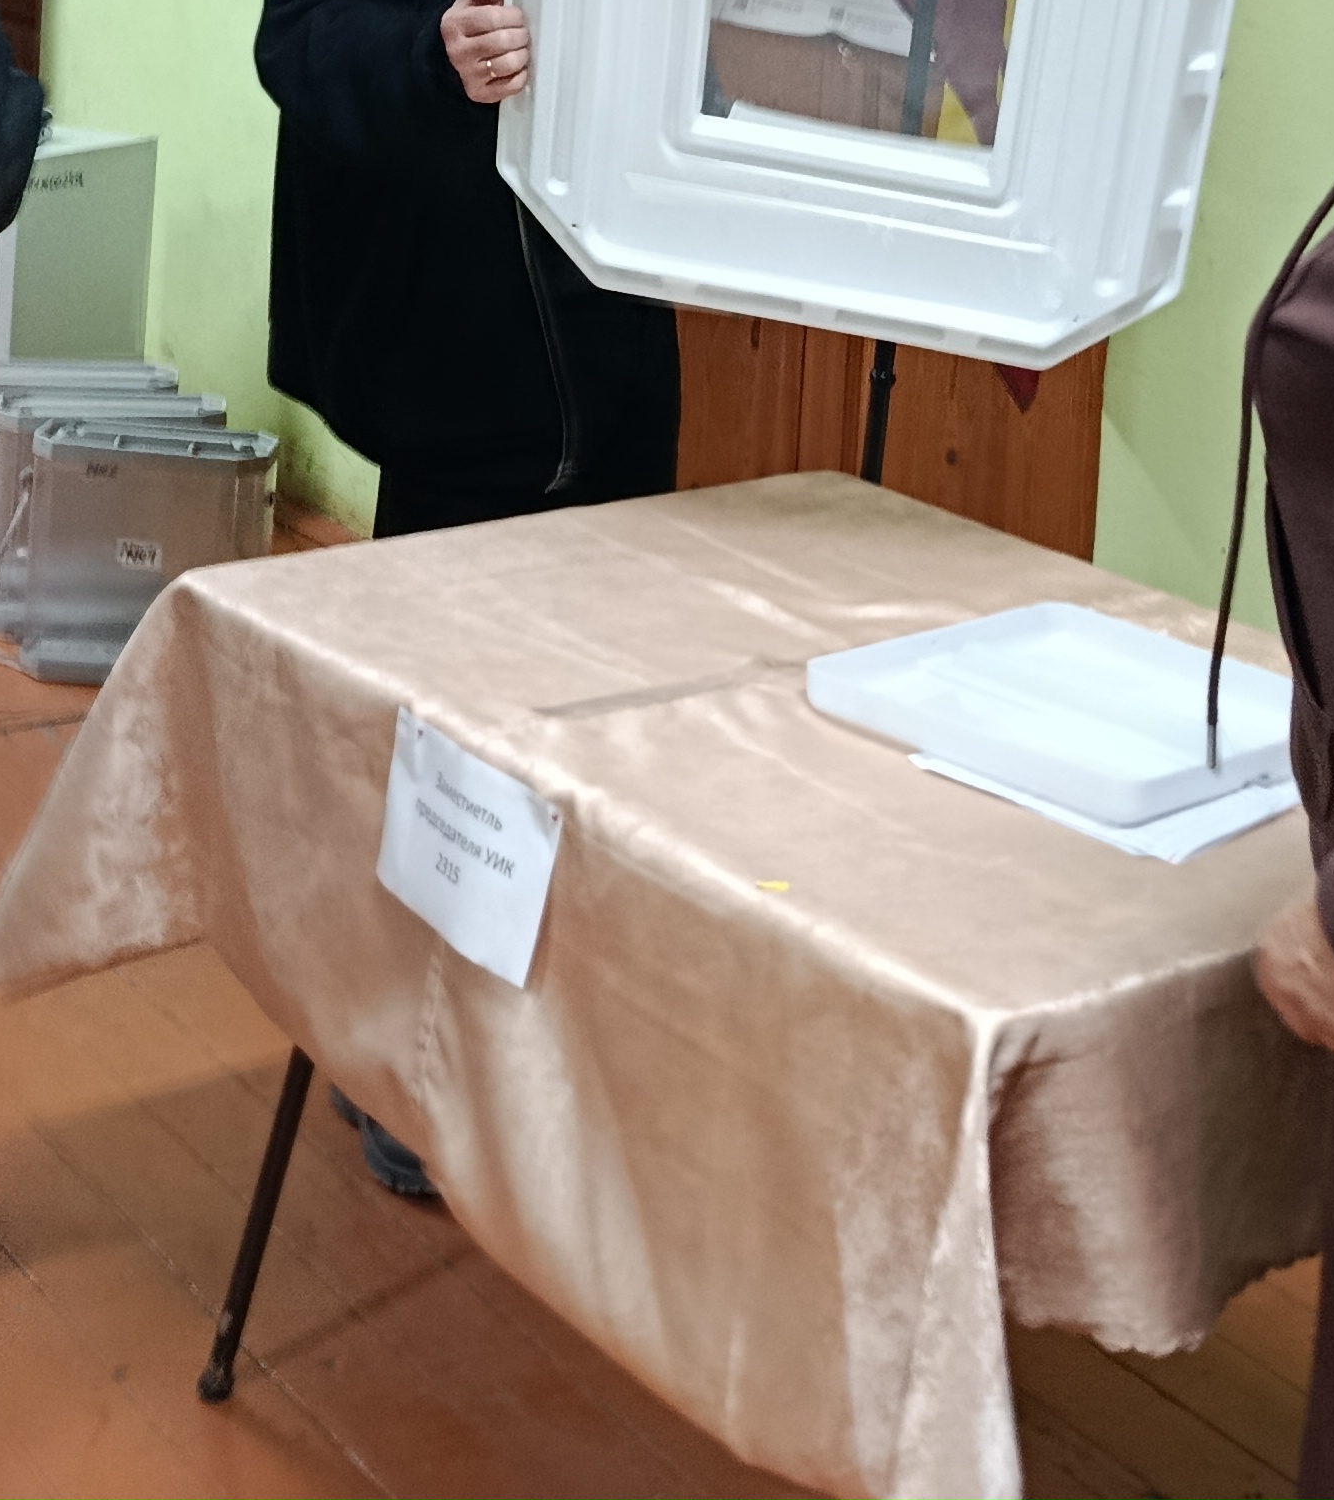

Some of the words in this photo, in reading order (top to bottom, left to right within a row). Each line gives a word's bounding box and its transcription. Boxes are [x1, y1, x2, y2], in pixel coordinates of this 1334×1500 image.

[414, 796, 483, 861] председателя
[484, 845, 516, 880] УИК
[435, 850, 461, 886] 2315
